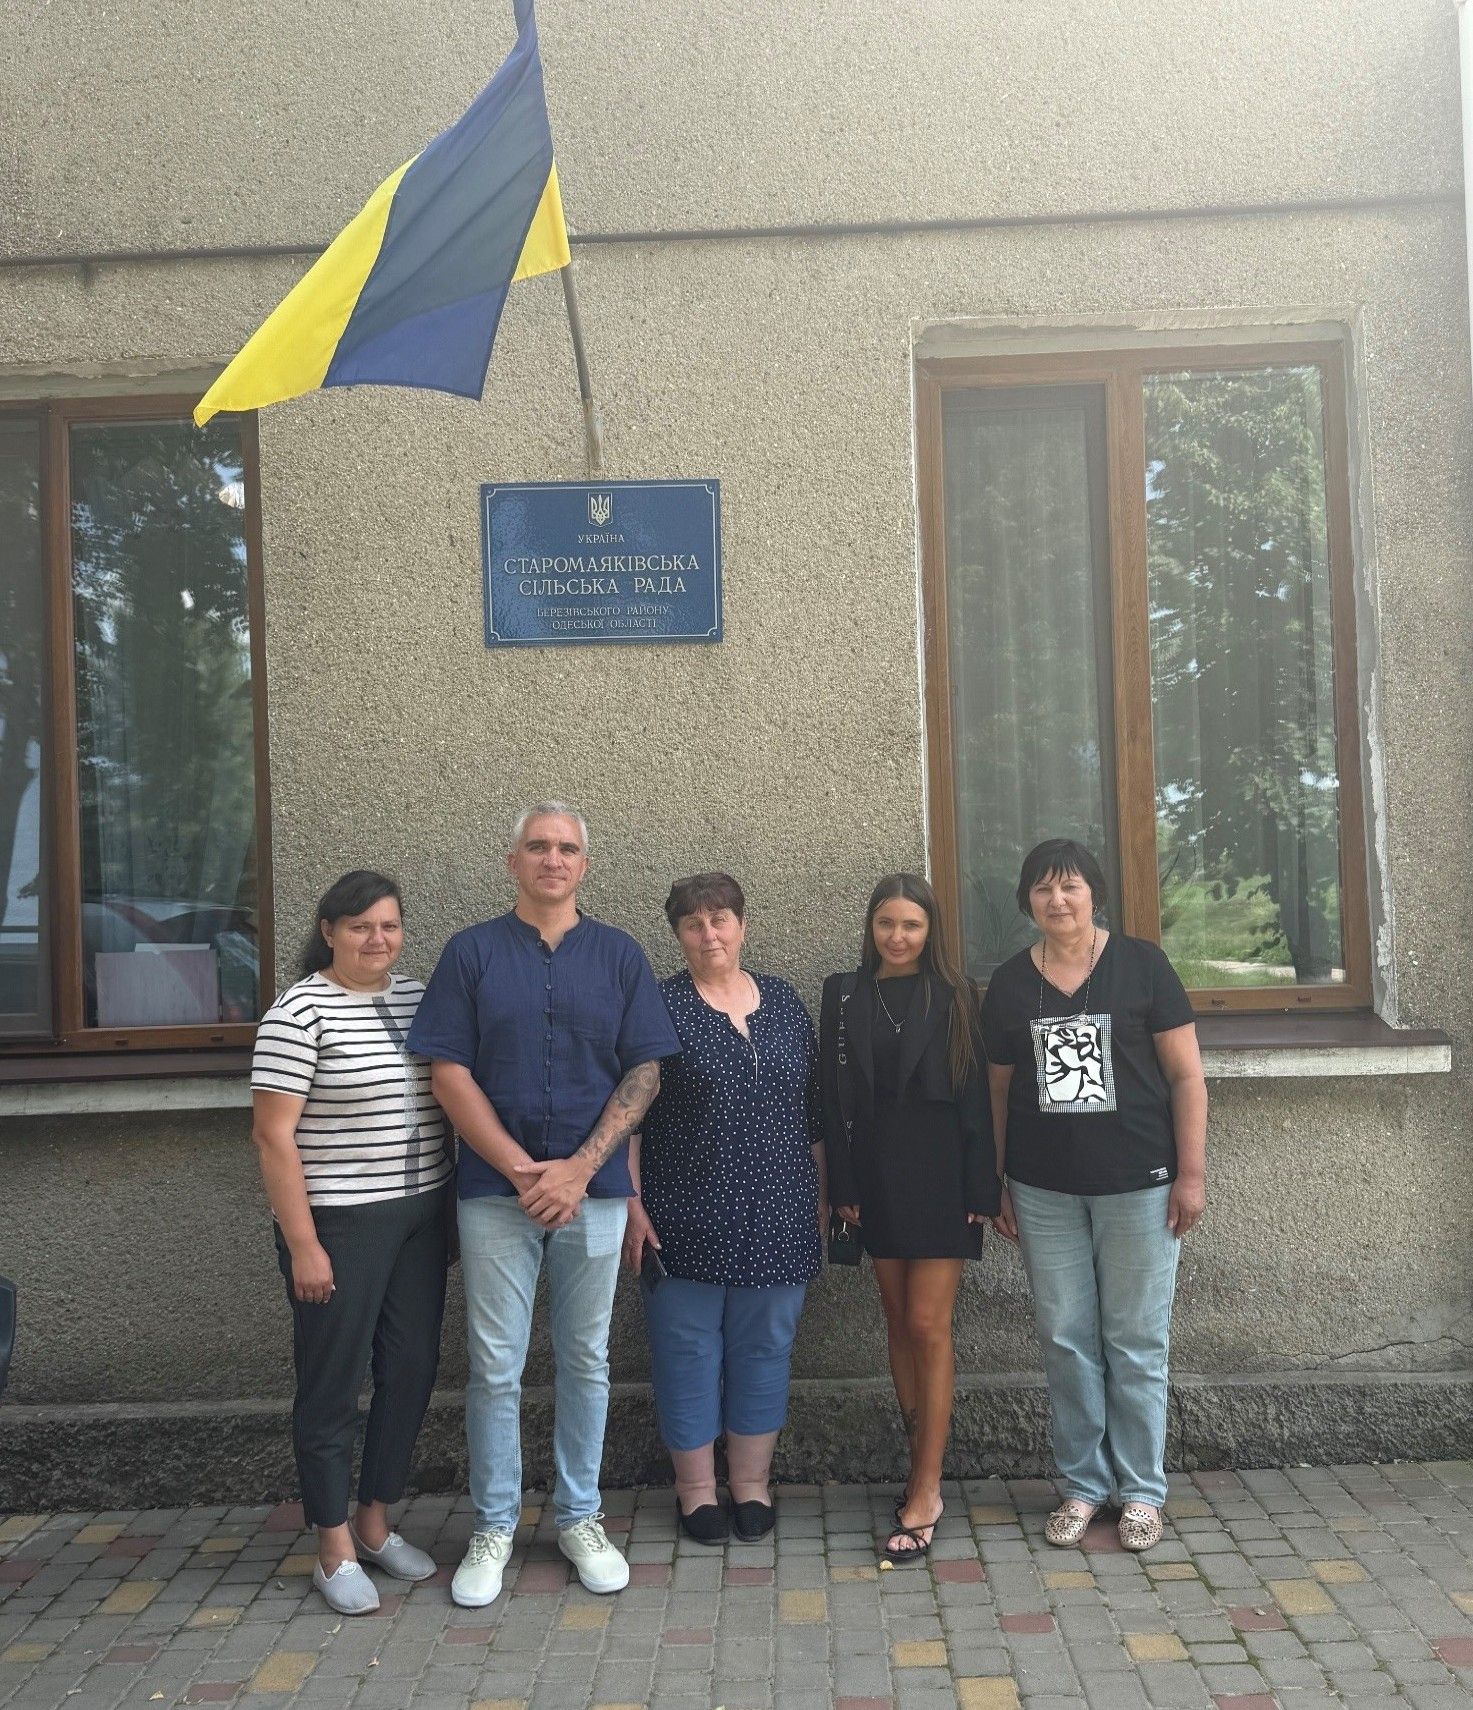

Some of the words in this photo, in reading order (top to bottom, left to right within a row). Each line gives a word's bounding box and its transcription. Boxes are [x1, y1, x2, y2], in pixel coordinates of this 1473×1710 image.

[577, 532, 625, 544] УКРАЇНА
[503, 554, 700, 575] СТАРОМАЯКІВСЬКА
[519, 578, 619, 596] СІЛЬСЬКА
[633, 576, 687, 595] РАДА
[537, 606, 620, 617] БЕРЕЗІВСЬКОГО
[627, 604, 669, 616] РАЙОНУ
[552, 619, 605, 630] ОДЕСЬКОЇ
[610, 618, 656, 629] ОБЛАСТІ
